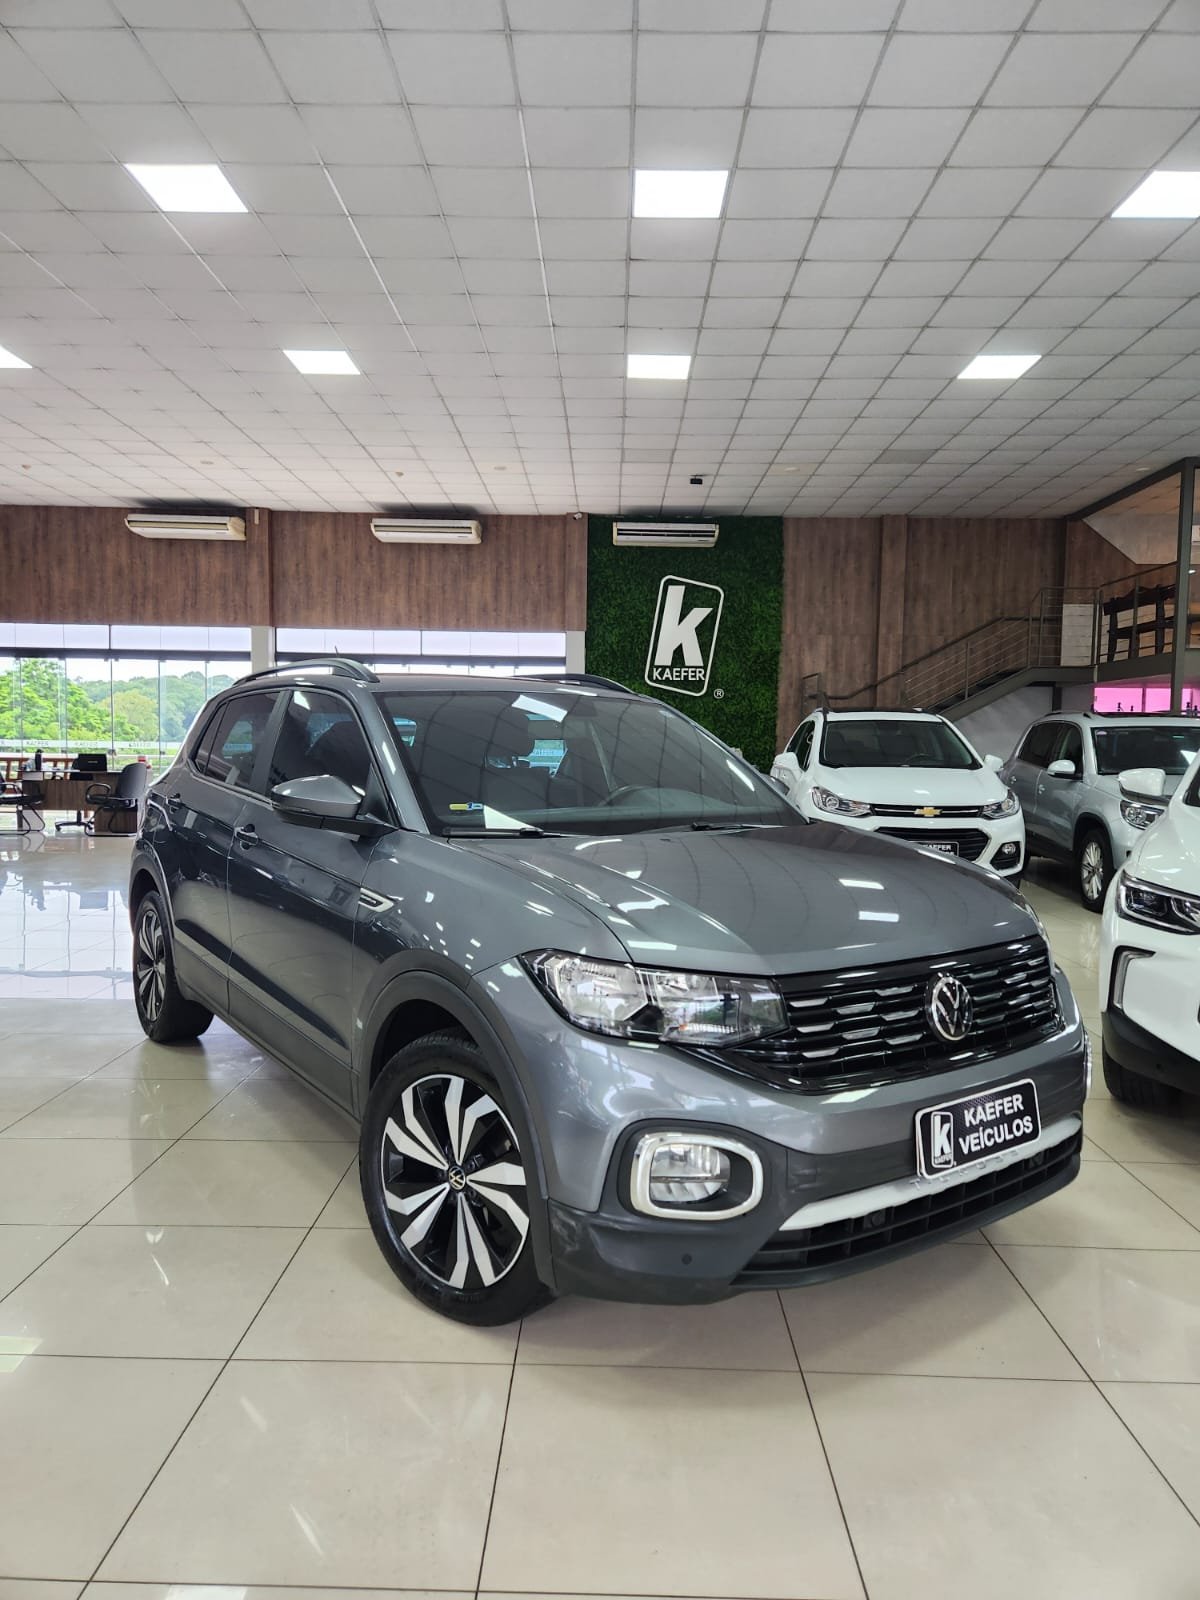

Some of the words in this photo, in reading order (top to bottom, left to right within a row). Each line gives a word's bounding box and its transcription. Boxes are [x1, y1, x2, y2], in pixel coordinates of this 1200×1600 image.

[653, 668, 705, 681] KAEFER
[964, 1094, 1024, 1127] KAEFER
[959, 1115, 1033, 1155] VEÍCULOS
